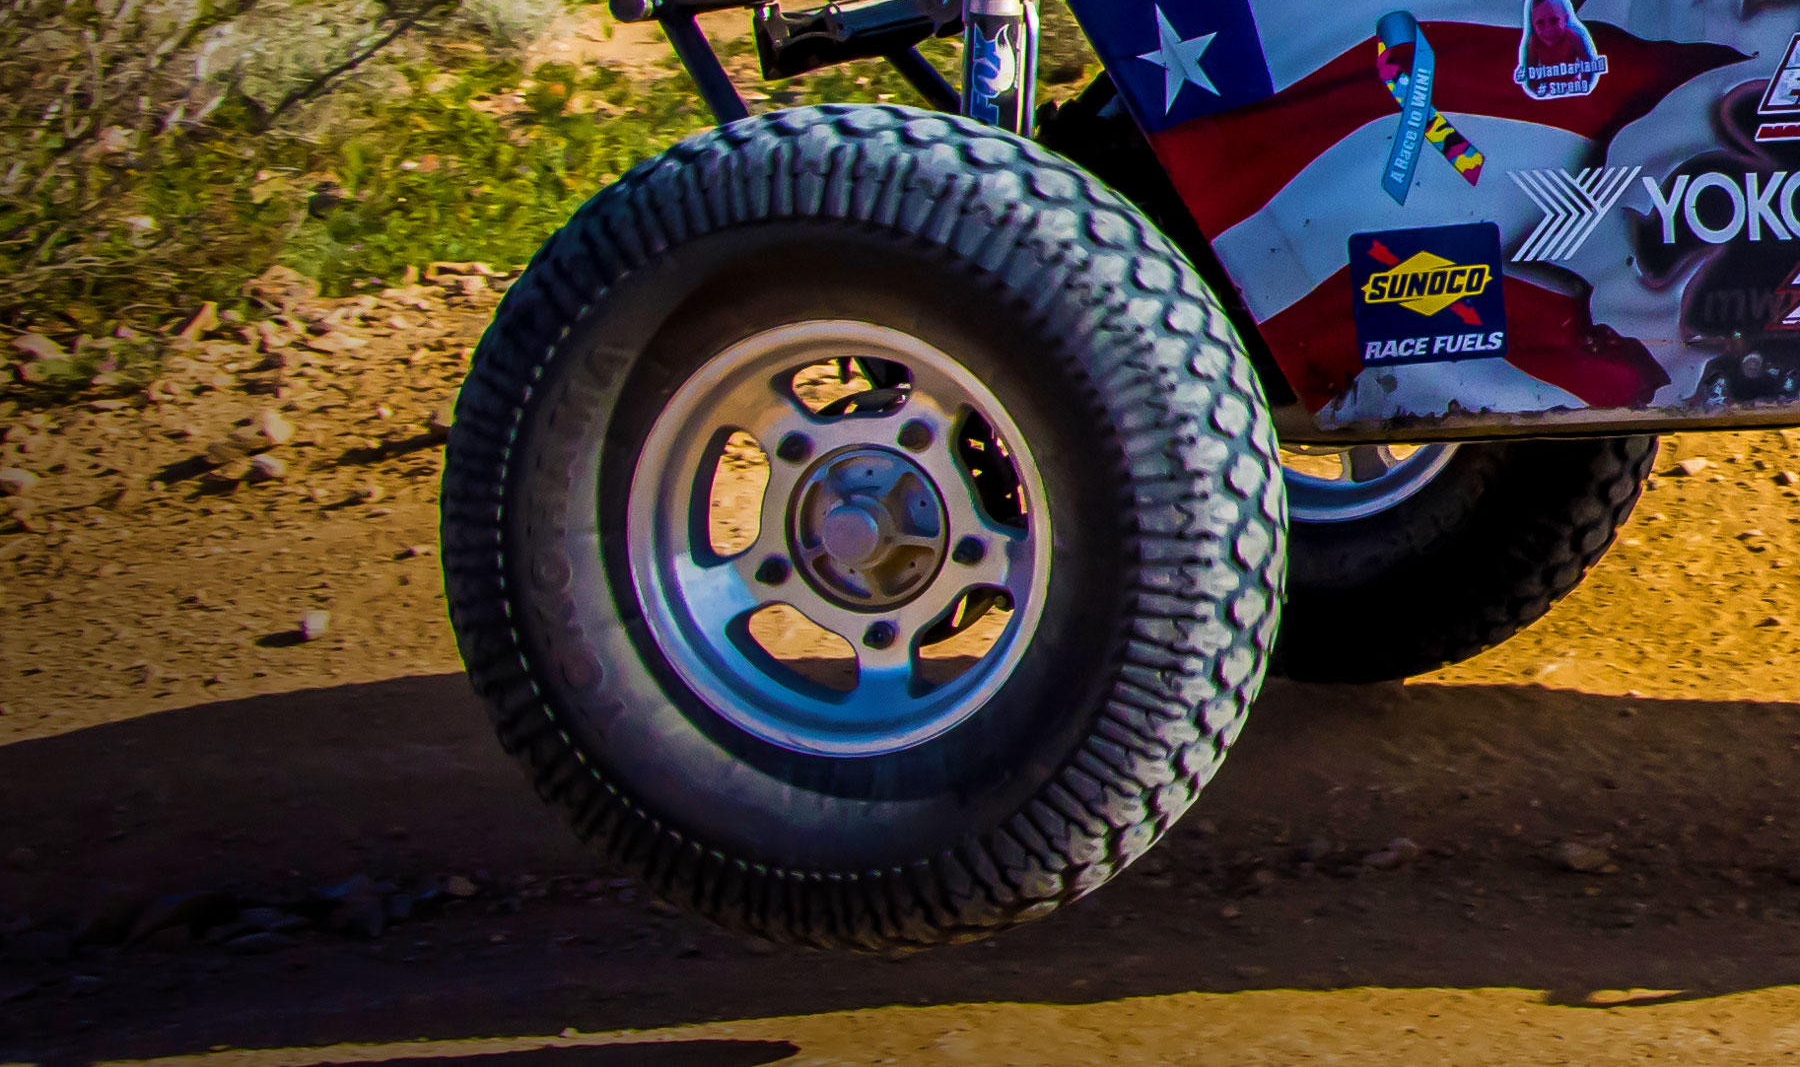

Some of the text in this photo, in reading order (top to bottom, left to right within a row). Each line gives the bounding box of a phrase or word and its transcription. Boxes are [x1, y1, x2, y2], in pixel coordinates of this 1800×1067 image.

[1411, 68, 1432, 109] WIN!
[1394, 130, 1418, 174] Race
[1389, 167, 1405, 184] A
[1367, 266, 1487, 301] SUNOCO
[1365, 331, 1504, 360] RACE FUELS
